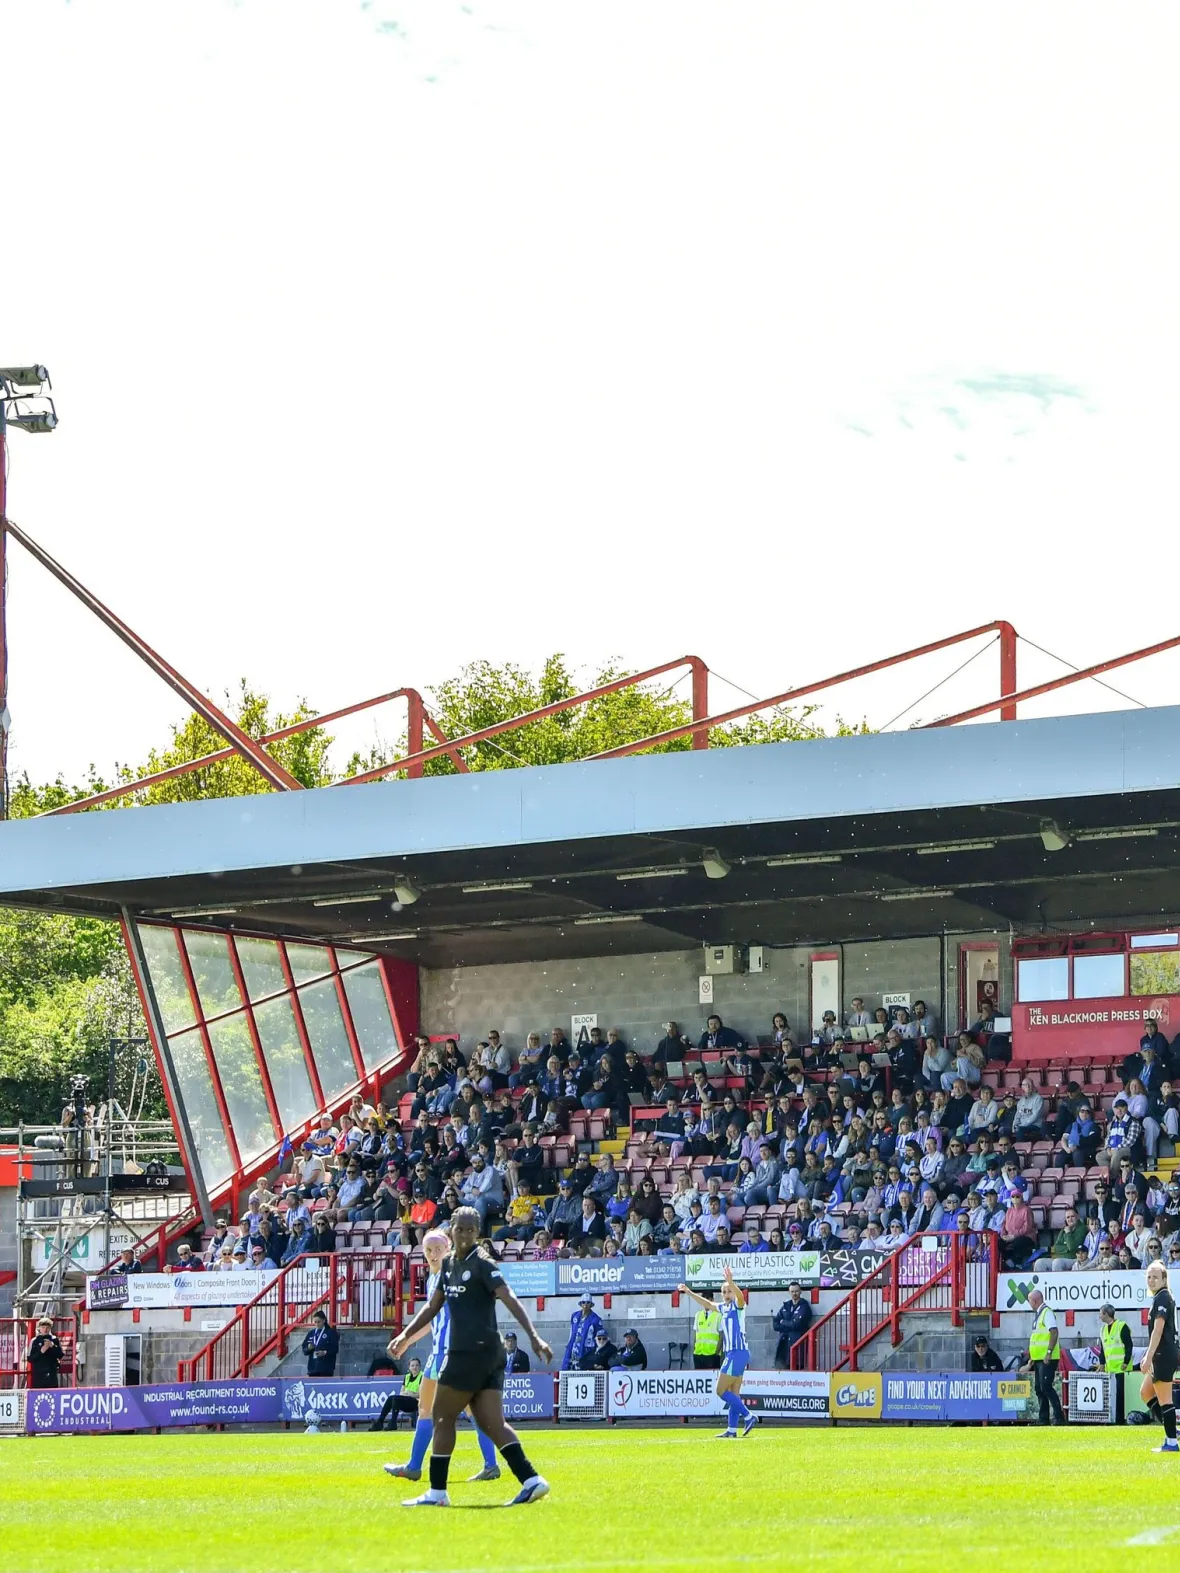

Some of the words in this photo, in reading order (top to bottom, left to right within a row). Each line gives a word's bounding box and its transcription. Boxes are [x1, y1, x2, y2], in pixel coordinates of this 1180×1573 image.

[574, 1016, 594, 1024] BLOCK
[1030, 1015, 1048, 1025] KEN
[1052, 1012, 1109, 1025] BLACKMORE
[1112, 1009, 1140, 1021] PRESS
[1143, 1009, 1163, 1019] BOX
[110, 1235, 128, 1243] EXITS
[709, 1257, 752, 1269] NEWLINE
[754, 1255, 795, 1267] PLASTICS
[571, 1263, 625, 1284] Oander
[101, 1276, 128, 1289] GLAZING
[146, 1281, 171, 1289] Windows
[197, 1279, 225, 1288] Composite
[226, 1278, 240, 1287] Front
[241, 1278, 257, 1286] Doors
[1044, 1279, 1132, 1300] innovation
[91, 1290, 97, 1300] &
[98, 1285, 128, 1299] REPAIRS
[637, 1379, 713, 1394] MENSHARE
[787, 1380, 813, 1388] challenging
[888, 1380, 904, 1399] FIND
[906, 1380, 926, 1400] YOUR
[927, 1380, 947, 1400] NEXT
[949, 1380, 992, 1400] ADVENTURE
[143, 1391, 184, 1402] INDUSTRIAL
[185, 1388, 235, 1401] RECRUITMENT
[236, 1387, 277, 1398] SOLUTIONS
[510, 1389, 535, 1399] FOOD
[574, 1384, 588, 1400] 19
[1083, 1387, 1097, 1403] 20
[60, 1393, 128, 1415] FOUND.
[307, 1389, 349, 1410] GREEK
[639, 1398, 680, 1408] LISTENING
[680, 1398, 710, 1408] GROUP
[763, 1397, 826, 1409] WWW.MSLG.ORG
[0, 1403, 13, 1417] 18
[170, 1403, 250, 1417] www.found-rs.co.uk
[887, 1403, 942, 1411] goape.co.uk/crawley
[60, 1415, 111, 1426] INDUSTRIAL
